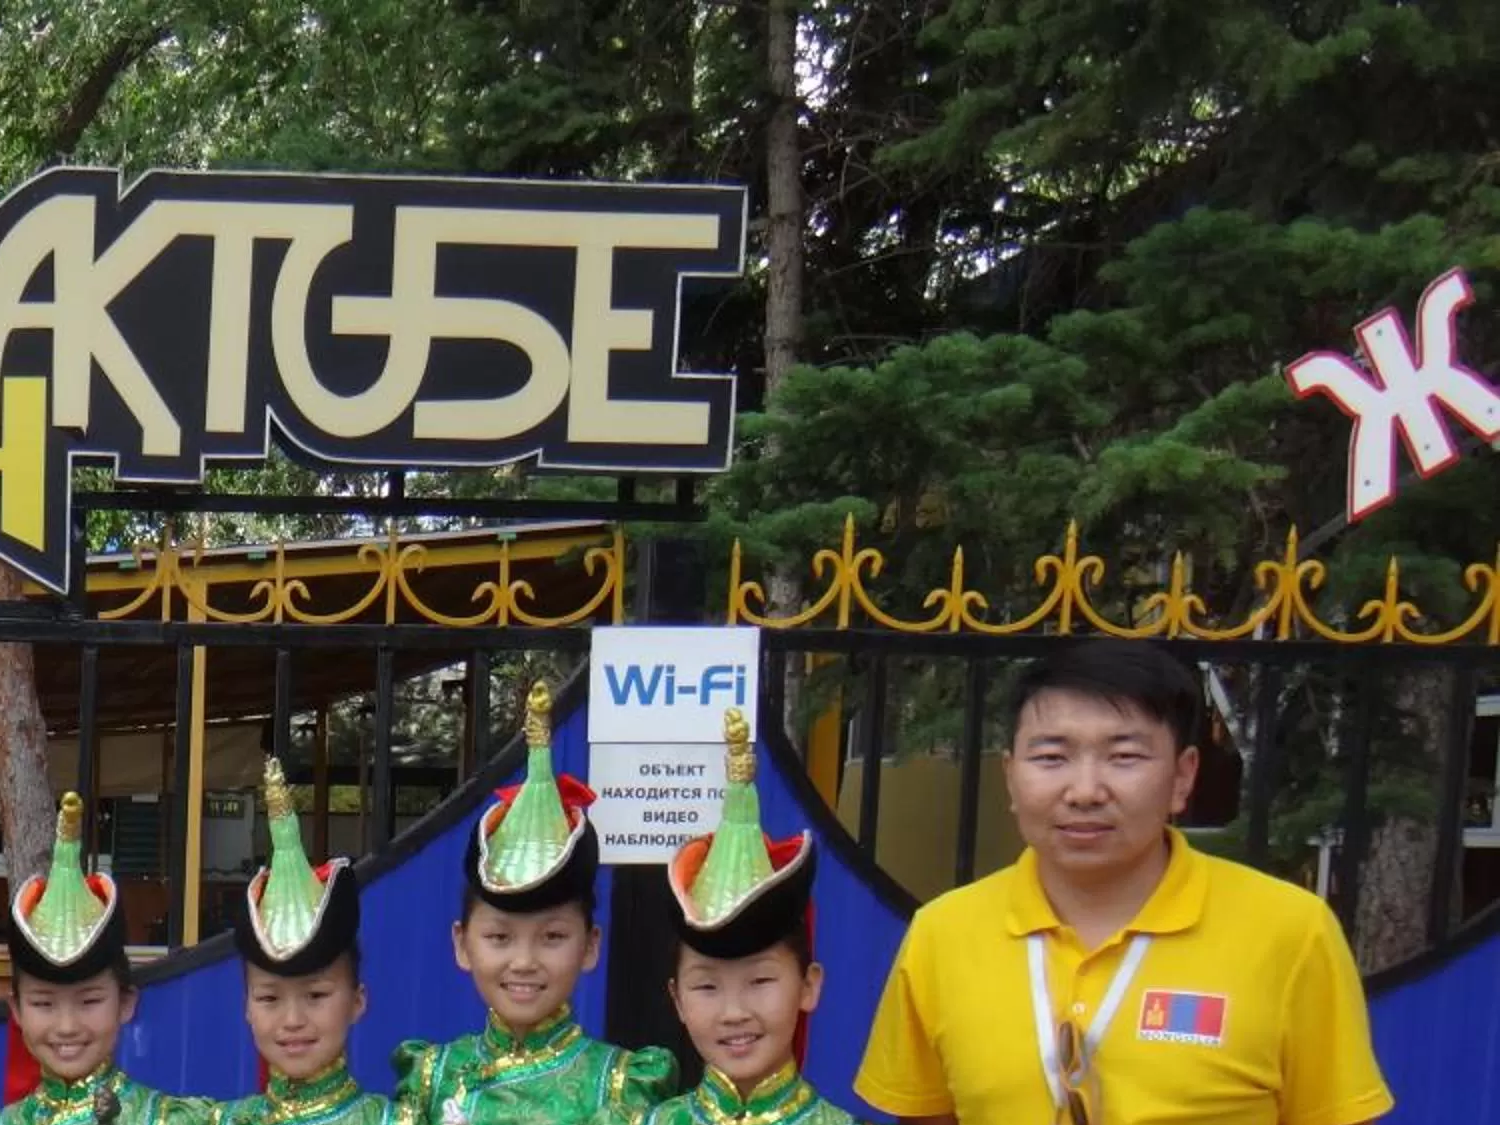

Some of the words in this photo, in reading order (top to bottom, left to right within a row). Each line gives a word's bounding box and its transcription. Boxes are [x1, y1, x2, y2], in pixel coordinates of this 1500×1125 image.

[604, 664, 747, 706] Wi-Fi
[638, 763, 707, 777] ОБЪЕКТ
[601, 787, 701, 801] НАХОДИТСЯ
[706, 788, 727, 799] ПО
[642, 811, 700, 825] ВИДЕО
